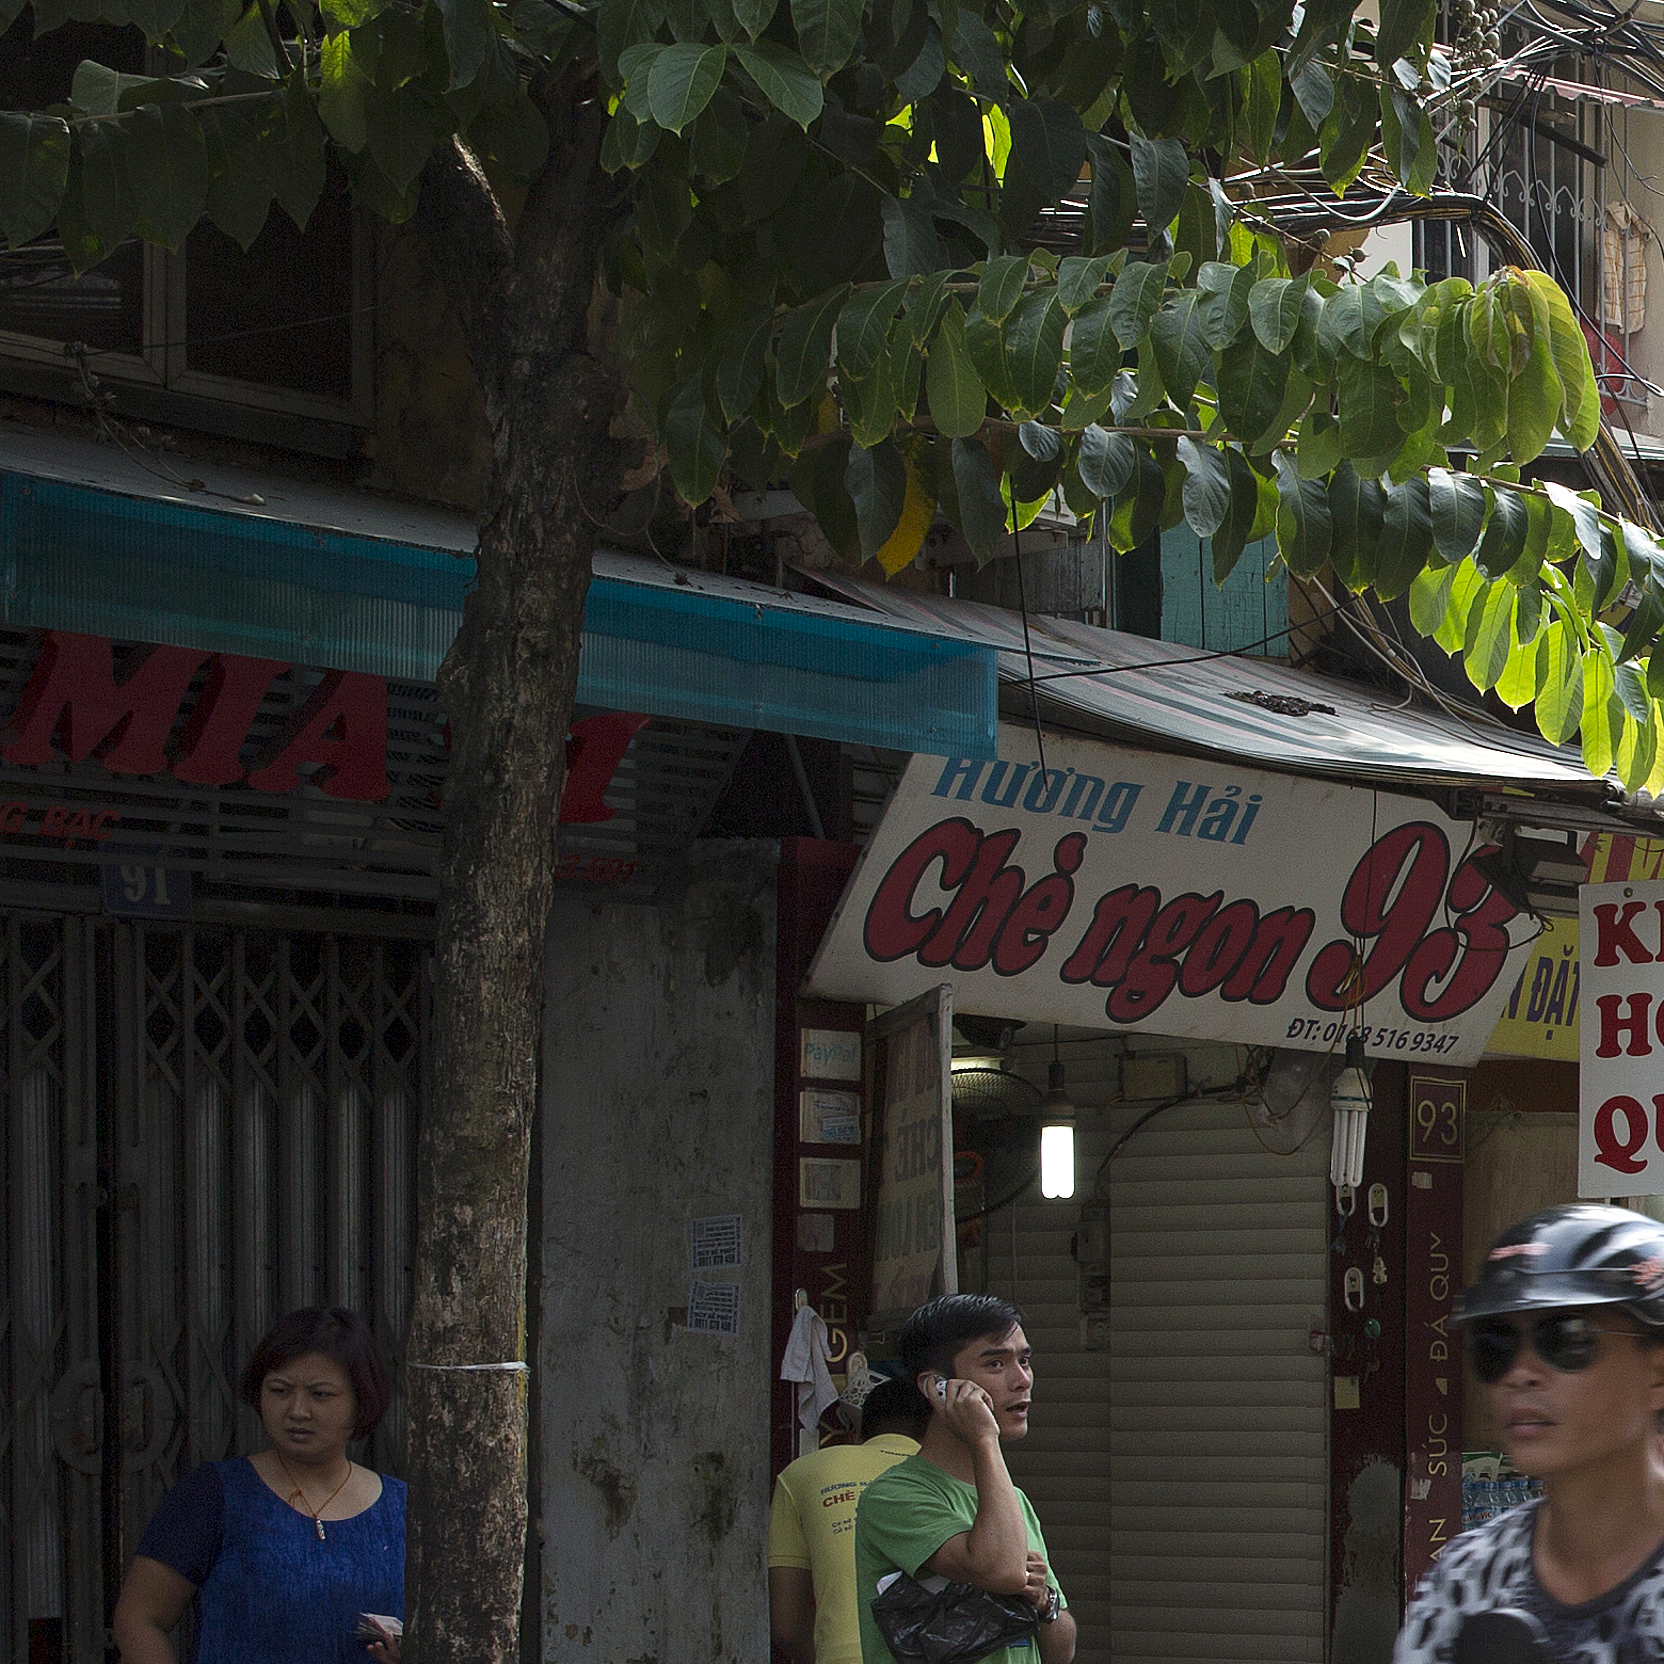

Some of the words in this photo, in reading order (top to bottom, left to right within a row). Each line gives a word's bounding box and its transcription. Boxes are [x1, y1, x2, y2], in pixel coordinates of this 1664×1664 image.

[1156, 781, 1263, 845] Hải
[1059, 883, 1316, 1023] ngon
[1305, 821, 1520, 1022] 93
[804, 1043, 857, 1066] PayPal
[1286, 1018, 1321, 1041] ĐT:
[1372, 1028, 1409, 1049] 516
[1409, 1032, 1460, 1054] 9347
[1417, 1100, 1458, 1146] 93
[818, 1262, 848, 1364] GEM
[822, 1489, 856, 1508] CHÈ
